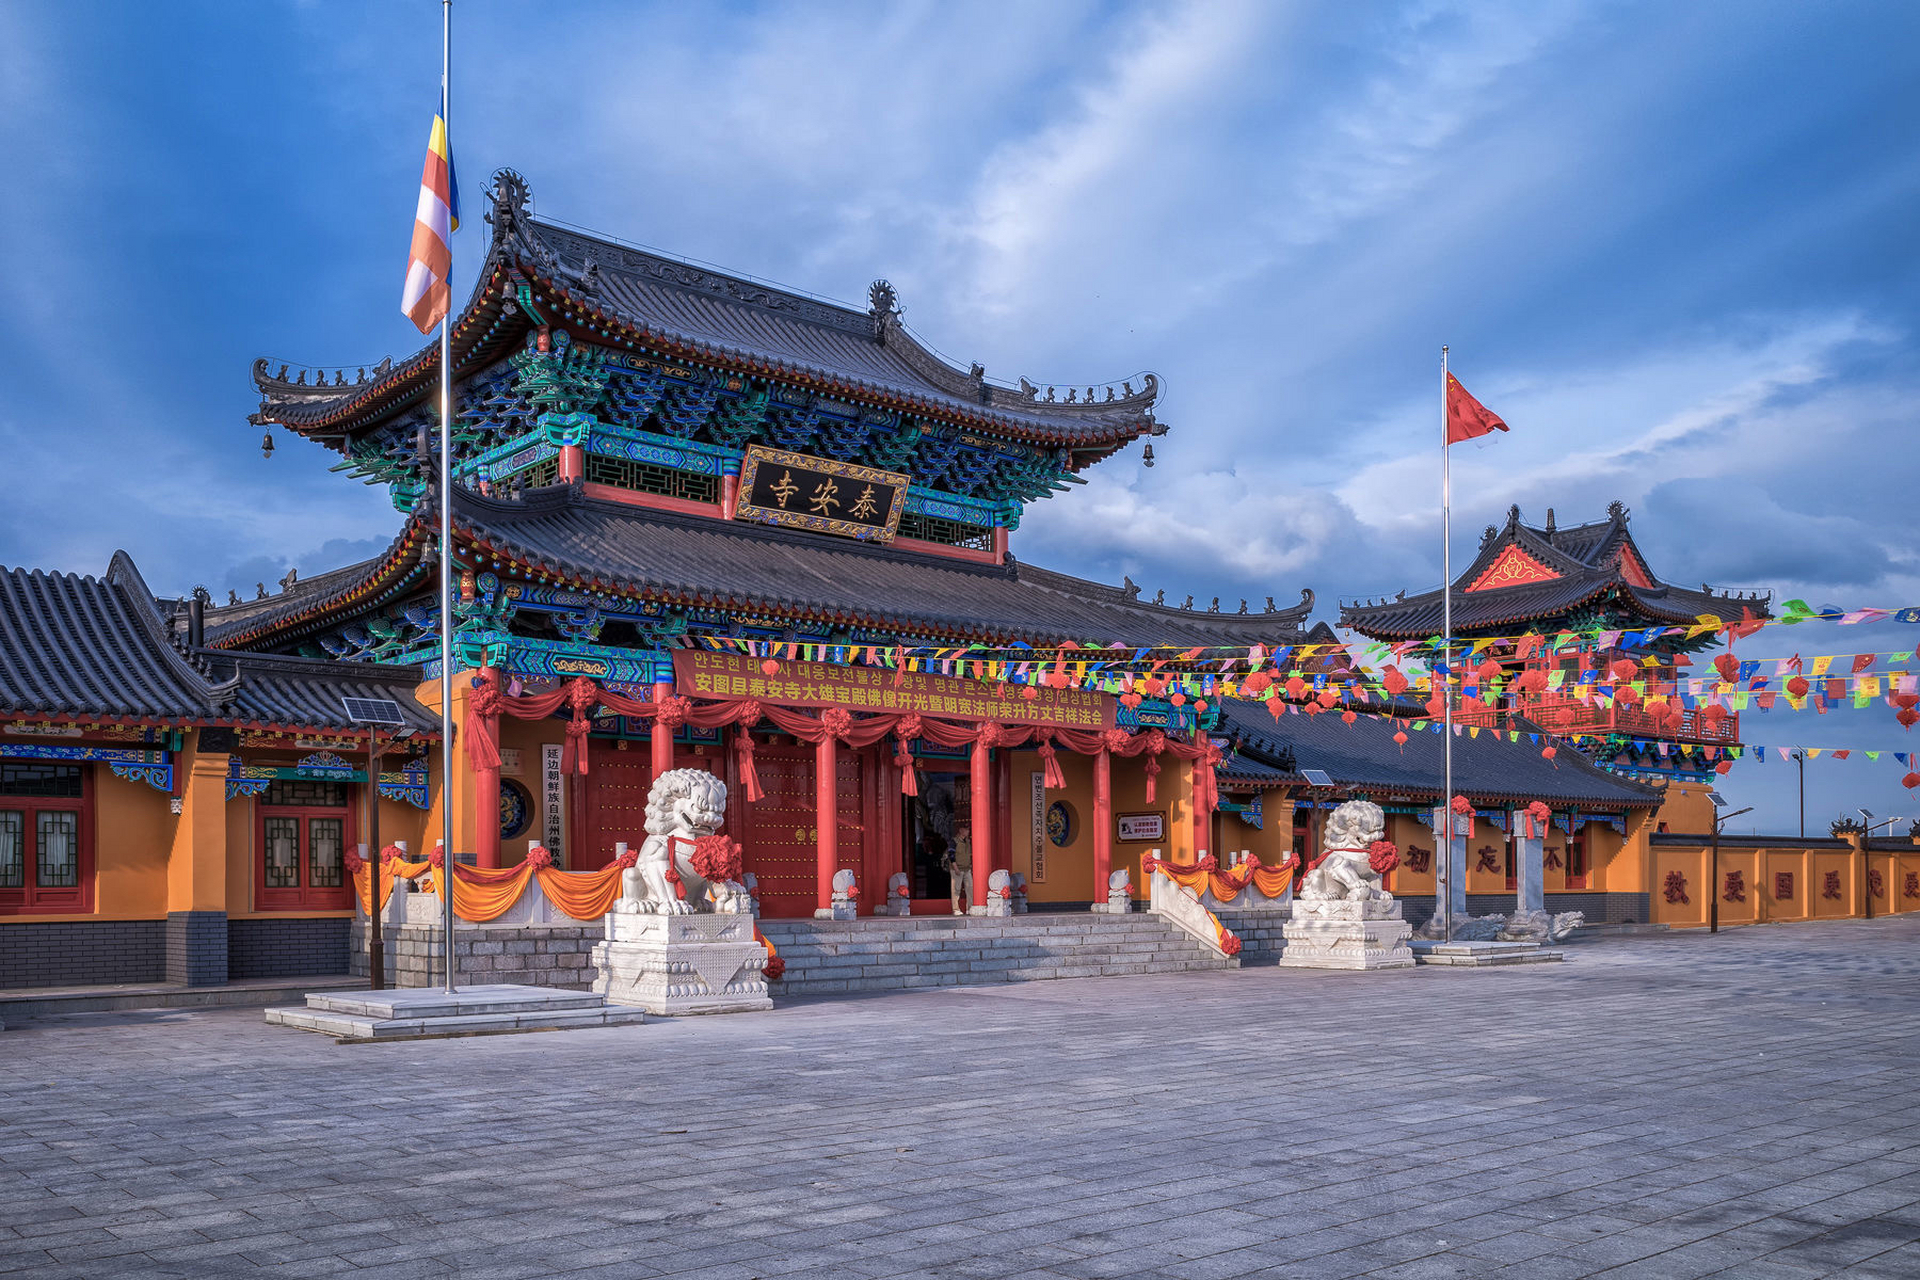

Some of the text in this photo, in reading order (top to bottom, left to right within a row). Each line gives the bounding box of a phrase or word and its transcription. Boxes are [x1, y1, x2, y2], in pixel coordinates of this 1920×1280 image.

[694, 652, 740, 672] 안도현
[747, 659, 791, 678] 태사
[797, 664, 882, 686] 대웅보전불상
